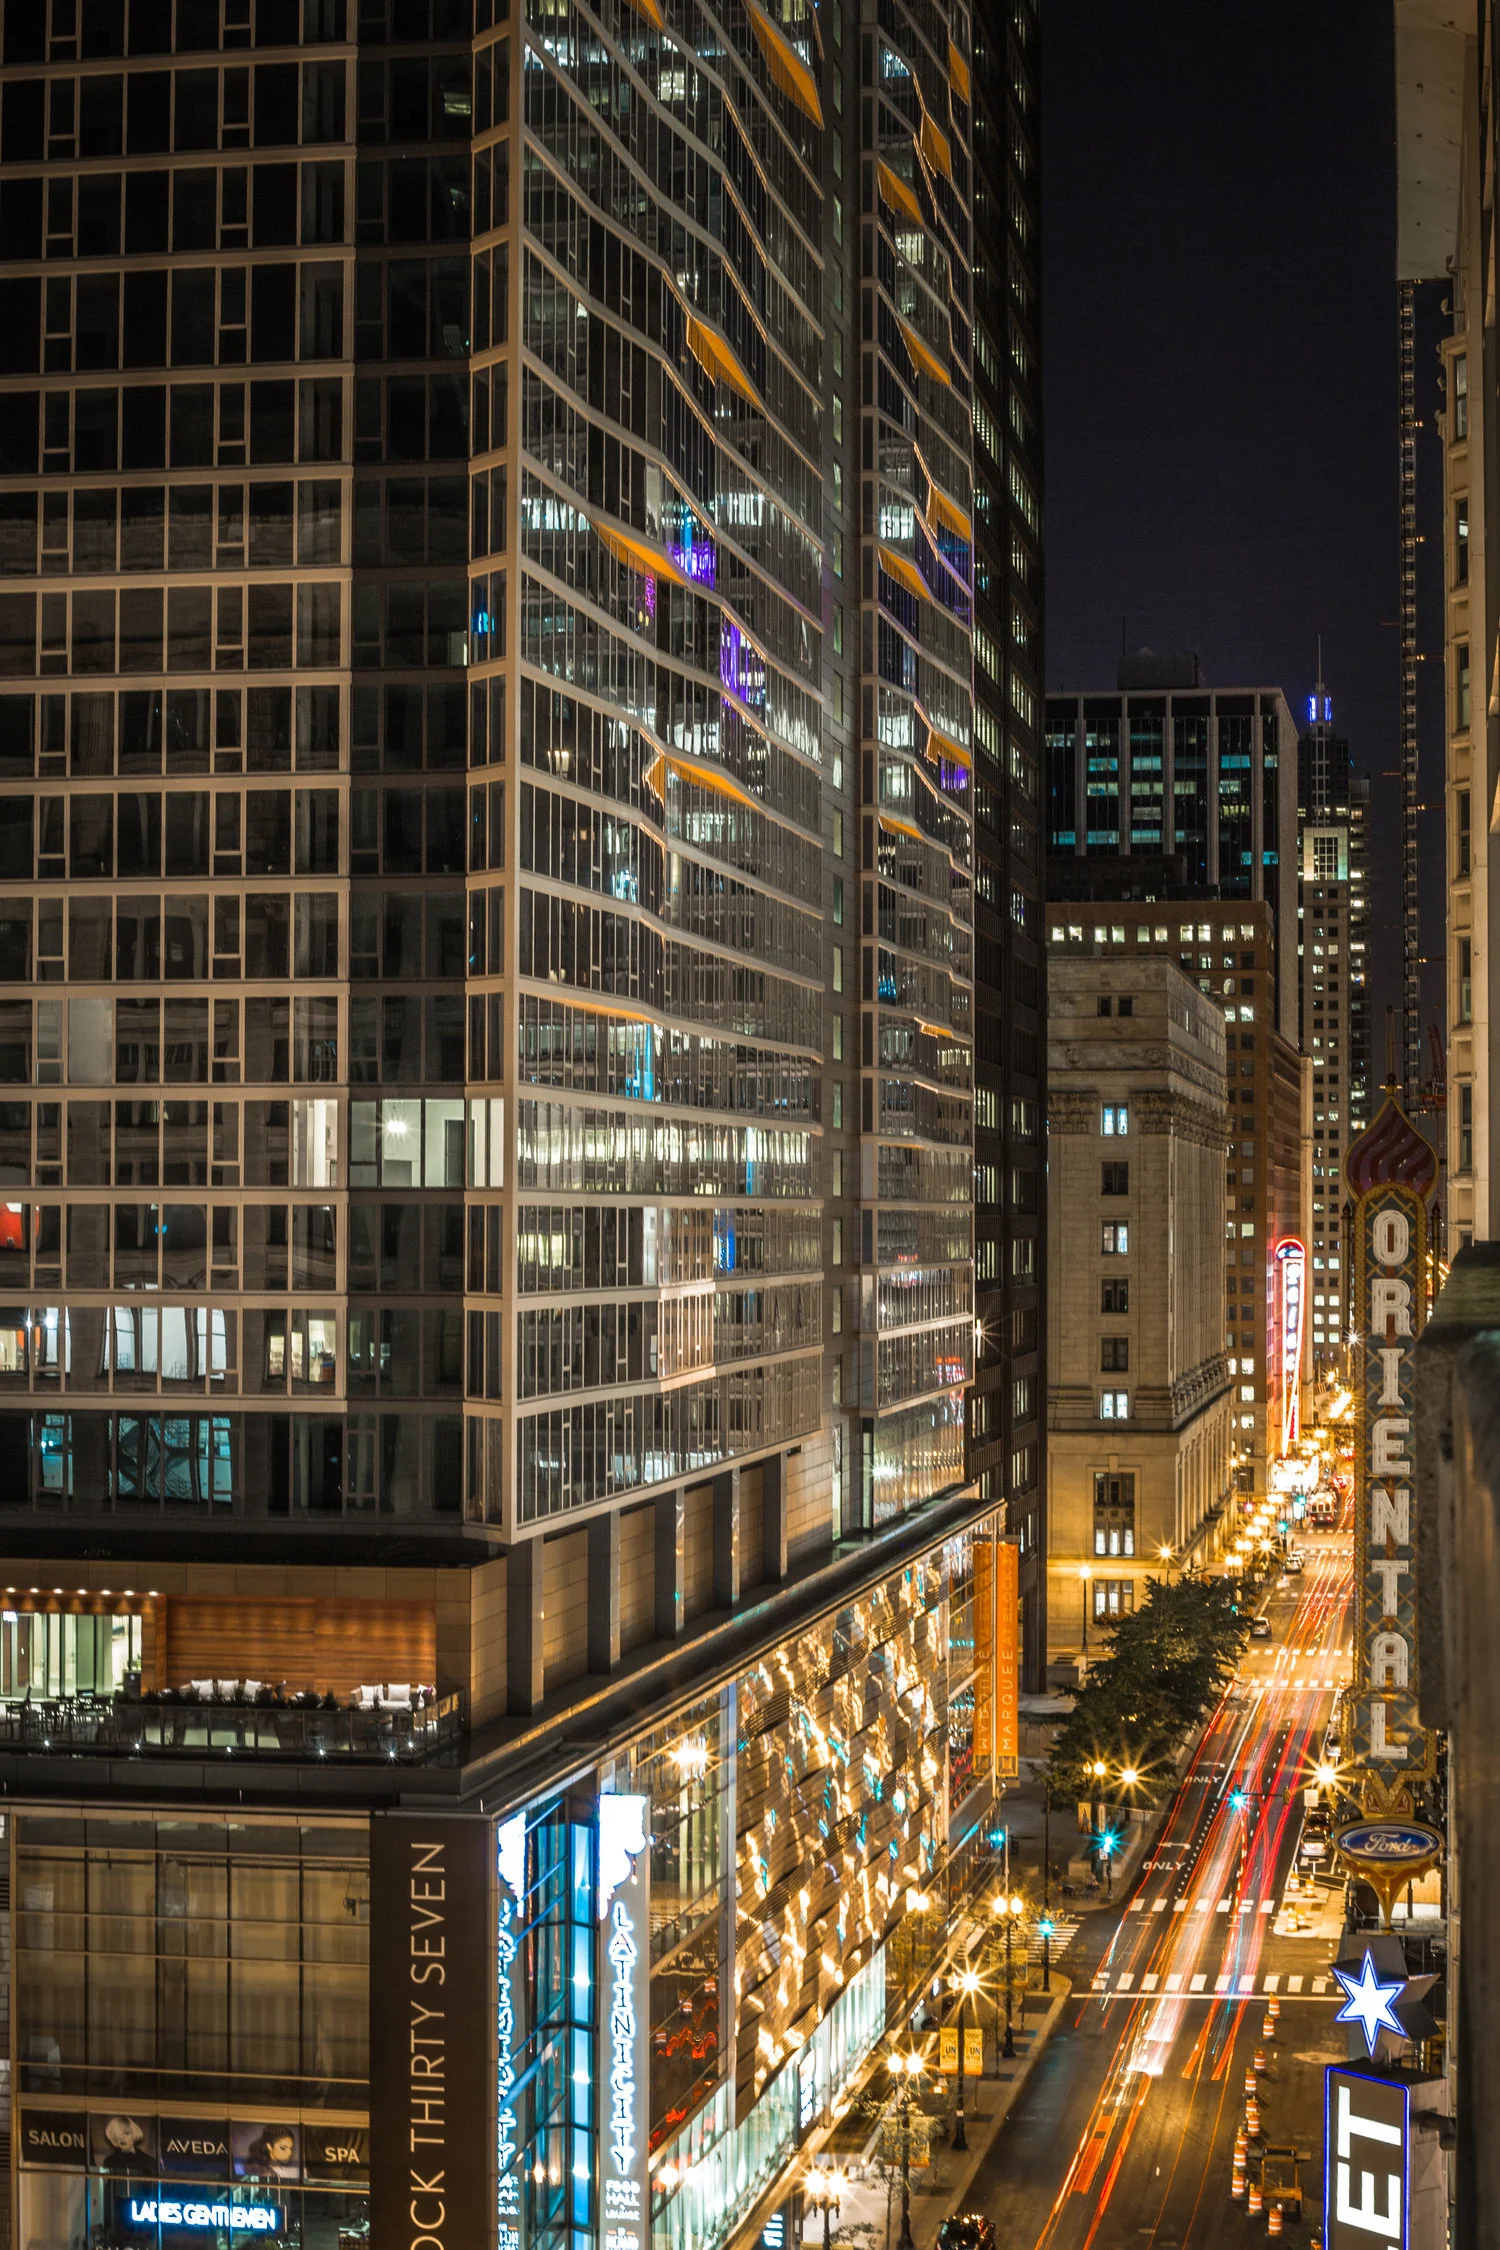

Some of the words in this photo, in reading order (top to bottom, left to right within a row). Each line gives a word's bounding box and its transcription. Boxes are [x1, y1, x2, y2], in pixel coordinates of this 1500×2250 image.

[1370, 1209, 1413, 1760] ORIENTAL
[1001, 1649, 1013, 1750] MARQUEE
[1142, 1861, 1187, 1870] ONLY
[1364, 1833, 1412, 1852] Ford
[410, 1842, 446, 1986] SEVEN
[610, 1902, 637, 2174] LATINICITY
[410, 2000, 446, 2153] THIRTY
[28, 2129, 85, 2148] SALON
[167, 2138, 229, 2155] AVEDA
[325, 2148, 361, 2164] SPA
